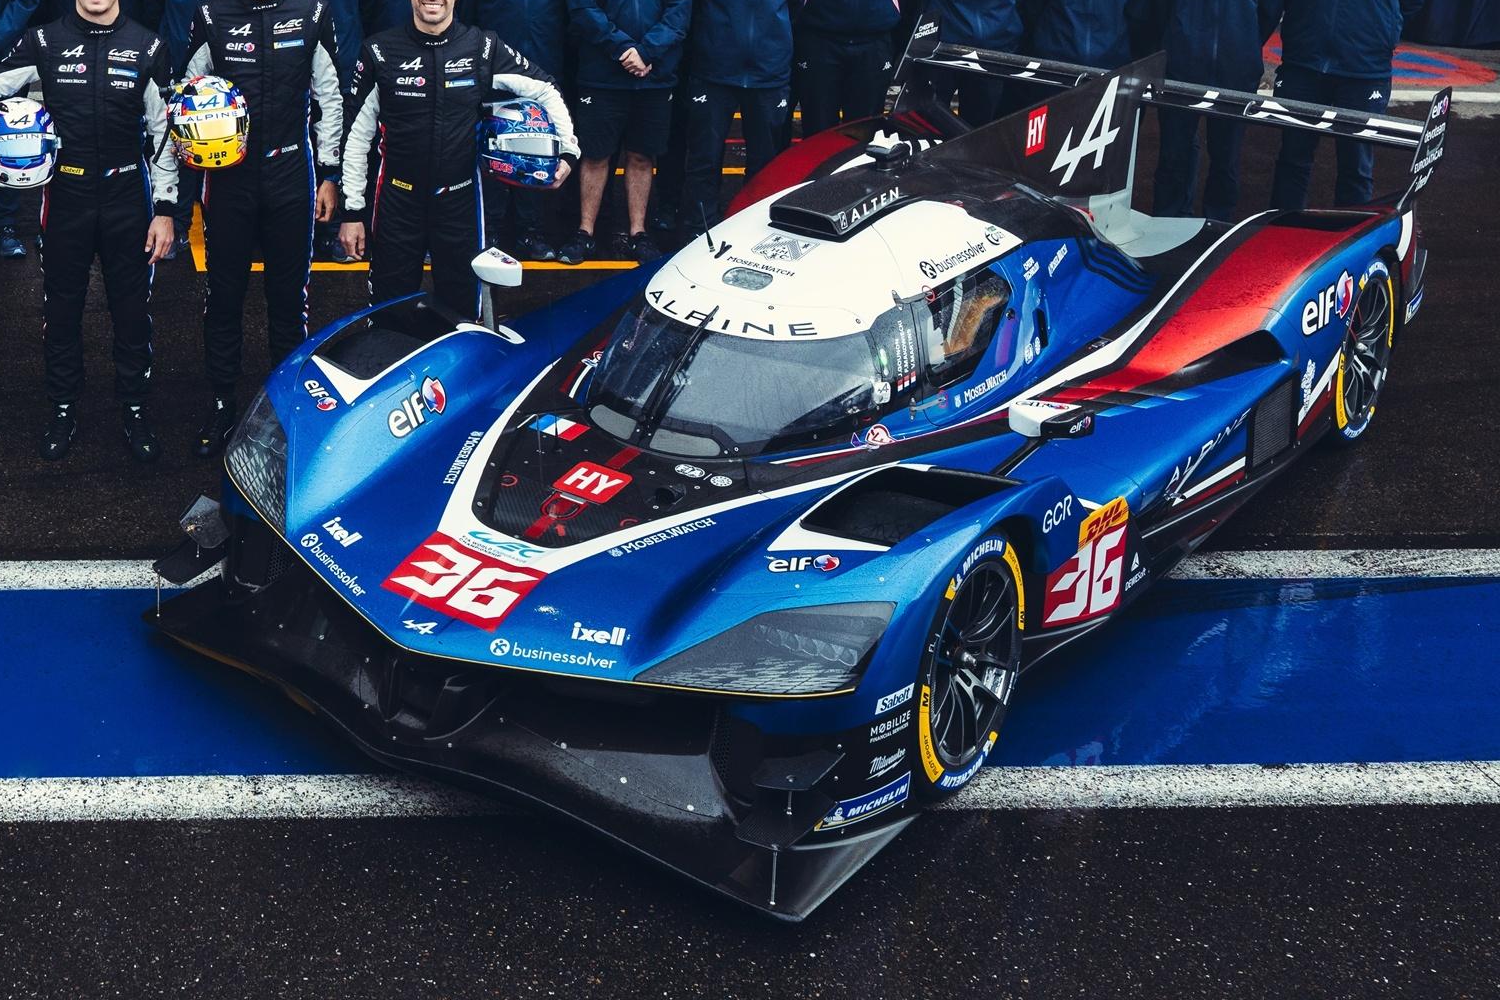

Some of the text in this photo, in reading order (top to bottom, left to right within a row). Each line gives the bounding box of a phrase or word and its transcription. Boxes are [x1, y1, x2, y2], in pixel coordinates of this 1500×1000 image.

[273, 18, 303, 29] WEC
[108, 48, 140, 58] WEC
[445, 58, 473, 68] WEC
[186, 110, 238, 122] ALPINE
[1026, 113, 1047, 149] HY
[207, 151, 227, 160] JBR
[850, 186, 900, 224] ALTEN
[727, 256, 796, 277] MOSER.WATCH
[931, 241, 987, 274] businessolver
[648, 290, 818, 337] ALPINE
[963, 369, 1008, 403] MOSER.WATCH
[1164, 408, 1252, 492] ALPINE
[563, 467, 625, 496] HY
[1042, 494, 1072, 534] GCR
[1086, 500, 1123, 541] DHL
[322, 516, 363, 548] ixell
[467, 531, 545, 558] WEC
[623, 517, 717, 553] MOSER.WATCH
[311, 543, 366, 597] businessolver
[769, 557, 812, 573] elf
[962, 539, 1005, 575] MICHELIN
[390, 544, 539, 618] 36
[1044, 525, 1127, 623] 36
[571, 621, 626, 646] ixell
[512, 640, 617, 670] businessolver
[880, 687, 911, 712] Sabelt
[922, 692, 929, 707] M
[869, 747, 906, 775] Milwaukee
[941, 755, 984, 788] MICHELIN
[847, 783, 908, 817] MICHELIN
